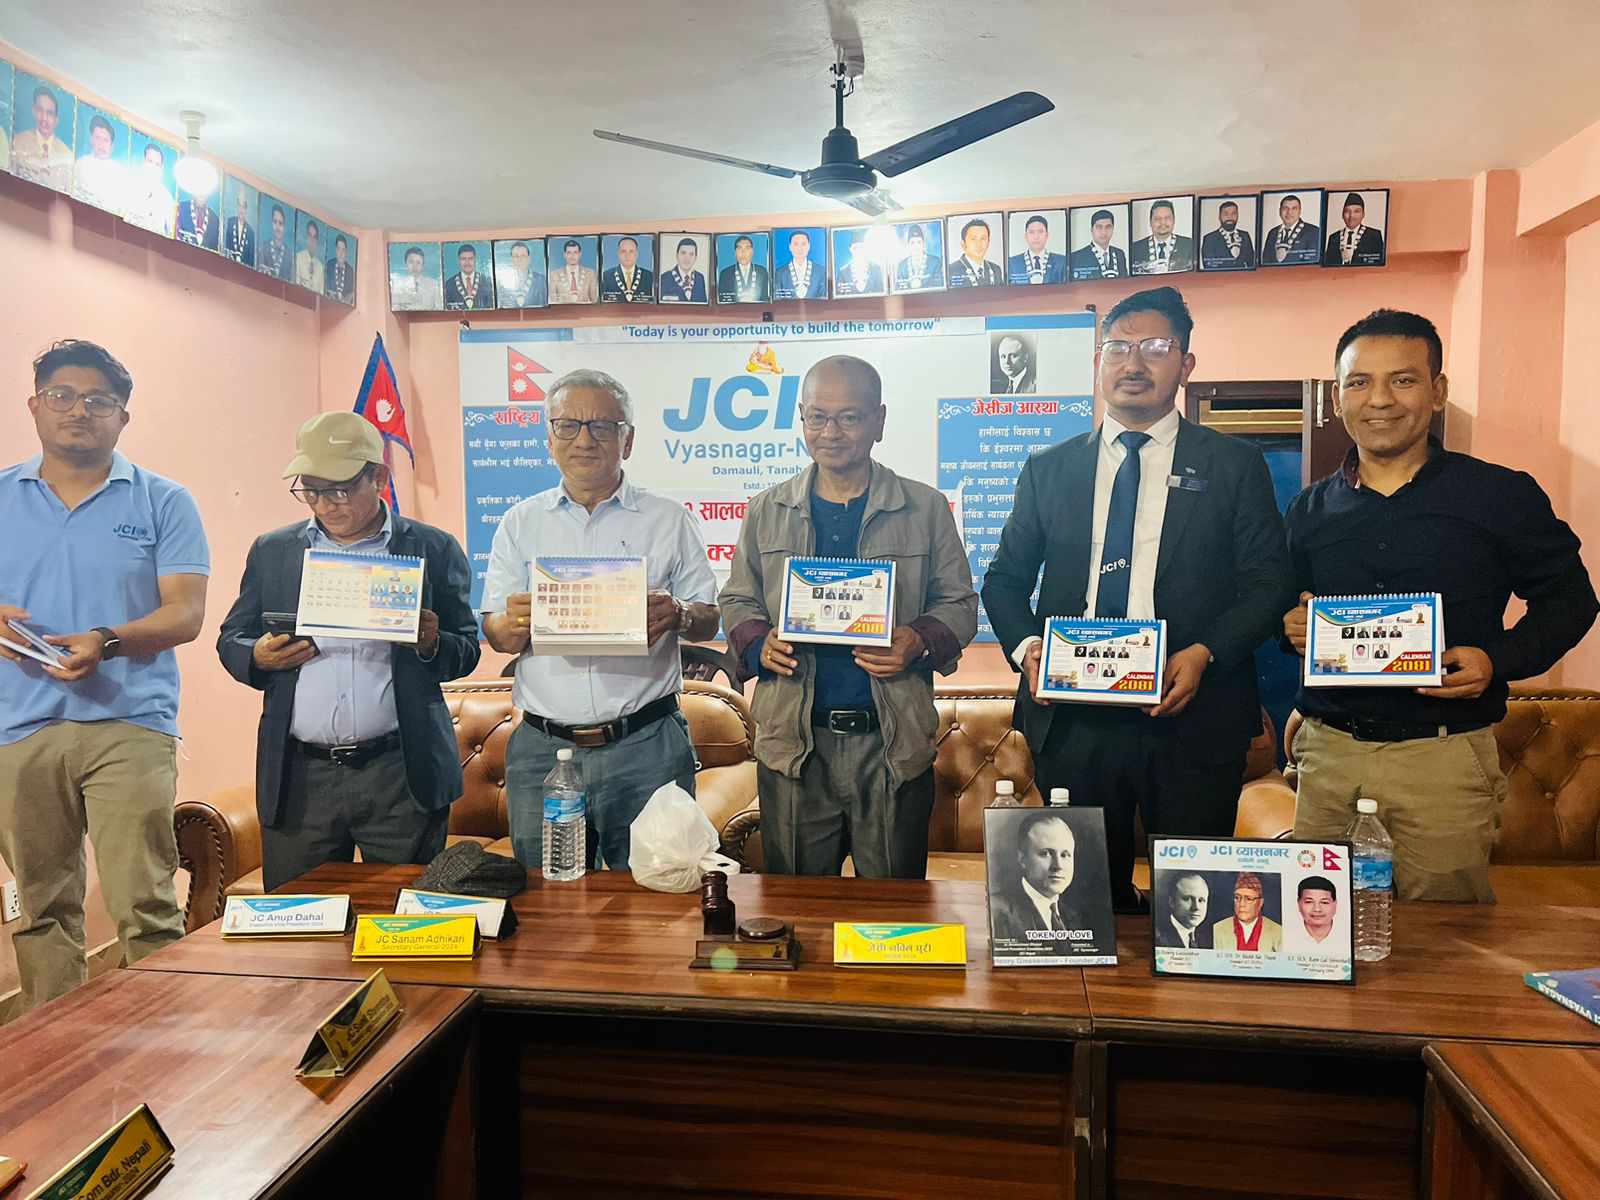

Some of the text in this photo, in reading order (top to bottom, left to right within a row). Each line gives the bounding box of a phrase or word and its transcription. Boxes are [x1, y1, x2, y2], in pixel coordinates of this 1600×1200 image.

[668, 325, 677, 337] is
[682, 326, 709, 339] your
[713, 323, 788, 338] opportunity
[791, 323, 804, 335] to
[808, 322, 840, 334] build
[844, 321, 865, 333] the
[663, 375, 800, 432] JCI
[971, 400, 1058, 416] जेसीज आस्था
[712, 466, 763, 476] Damauli,
[113, 524, 136, 535] JCI
[1100, 561, 1118, 574] JCI
[1159, 846, 1184, 858] JCI
[1210, 845, 1232, 856] JCI
[250, 912, 324, 924] JC Anup Dahal
[376, 935, 389, 944] JC
[1027, 931, 1093, 940] TOKEN OF LOVE
